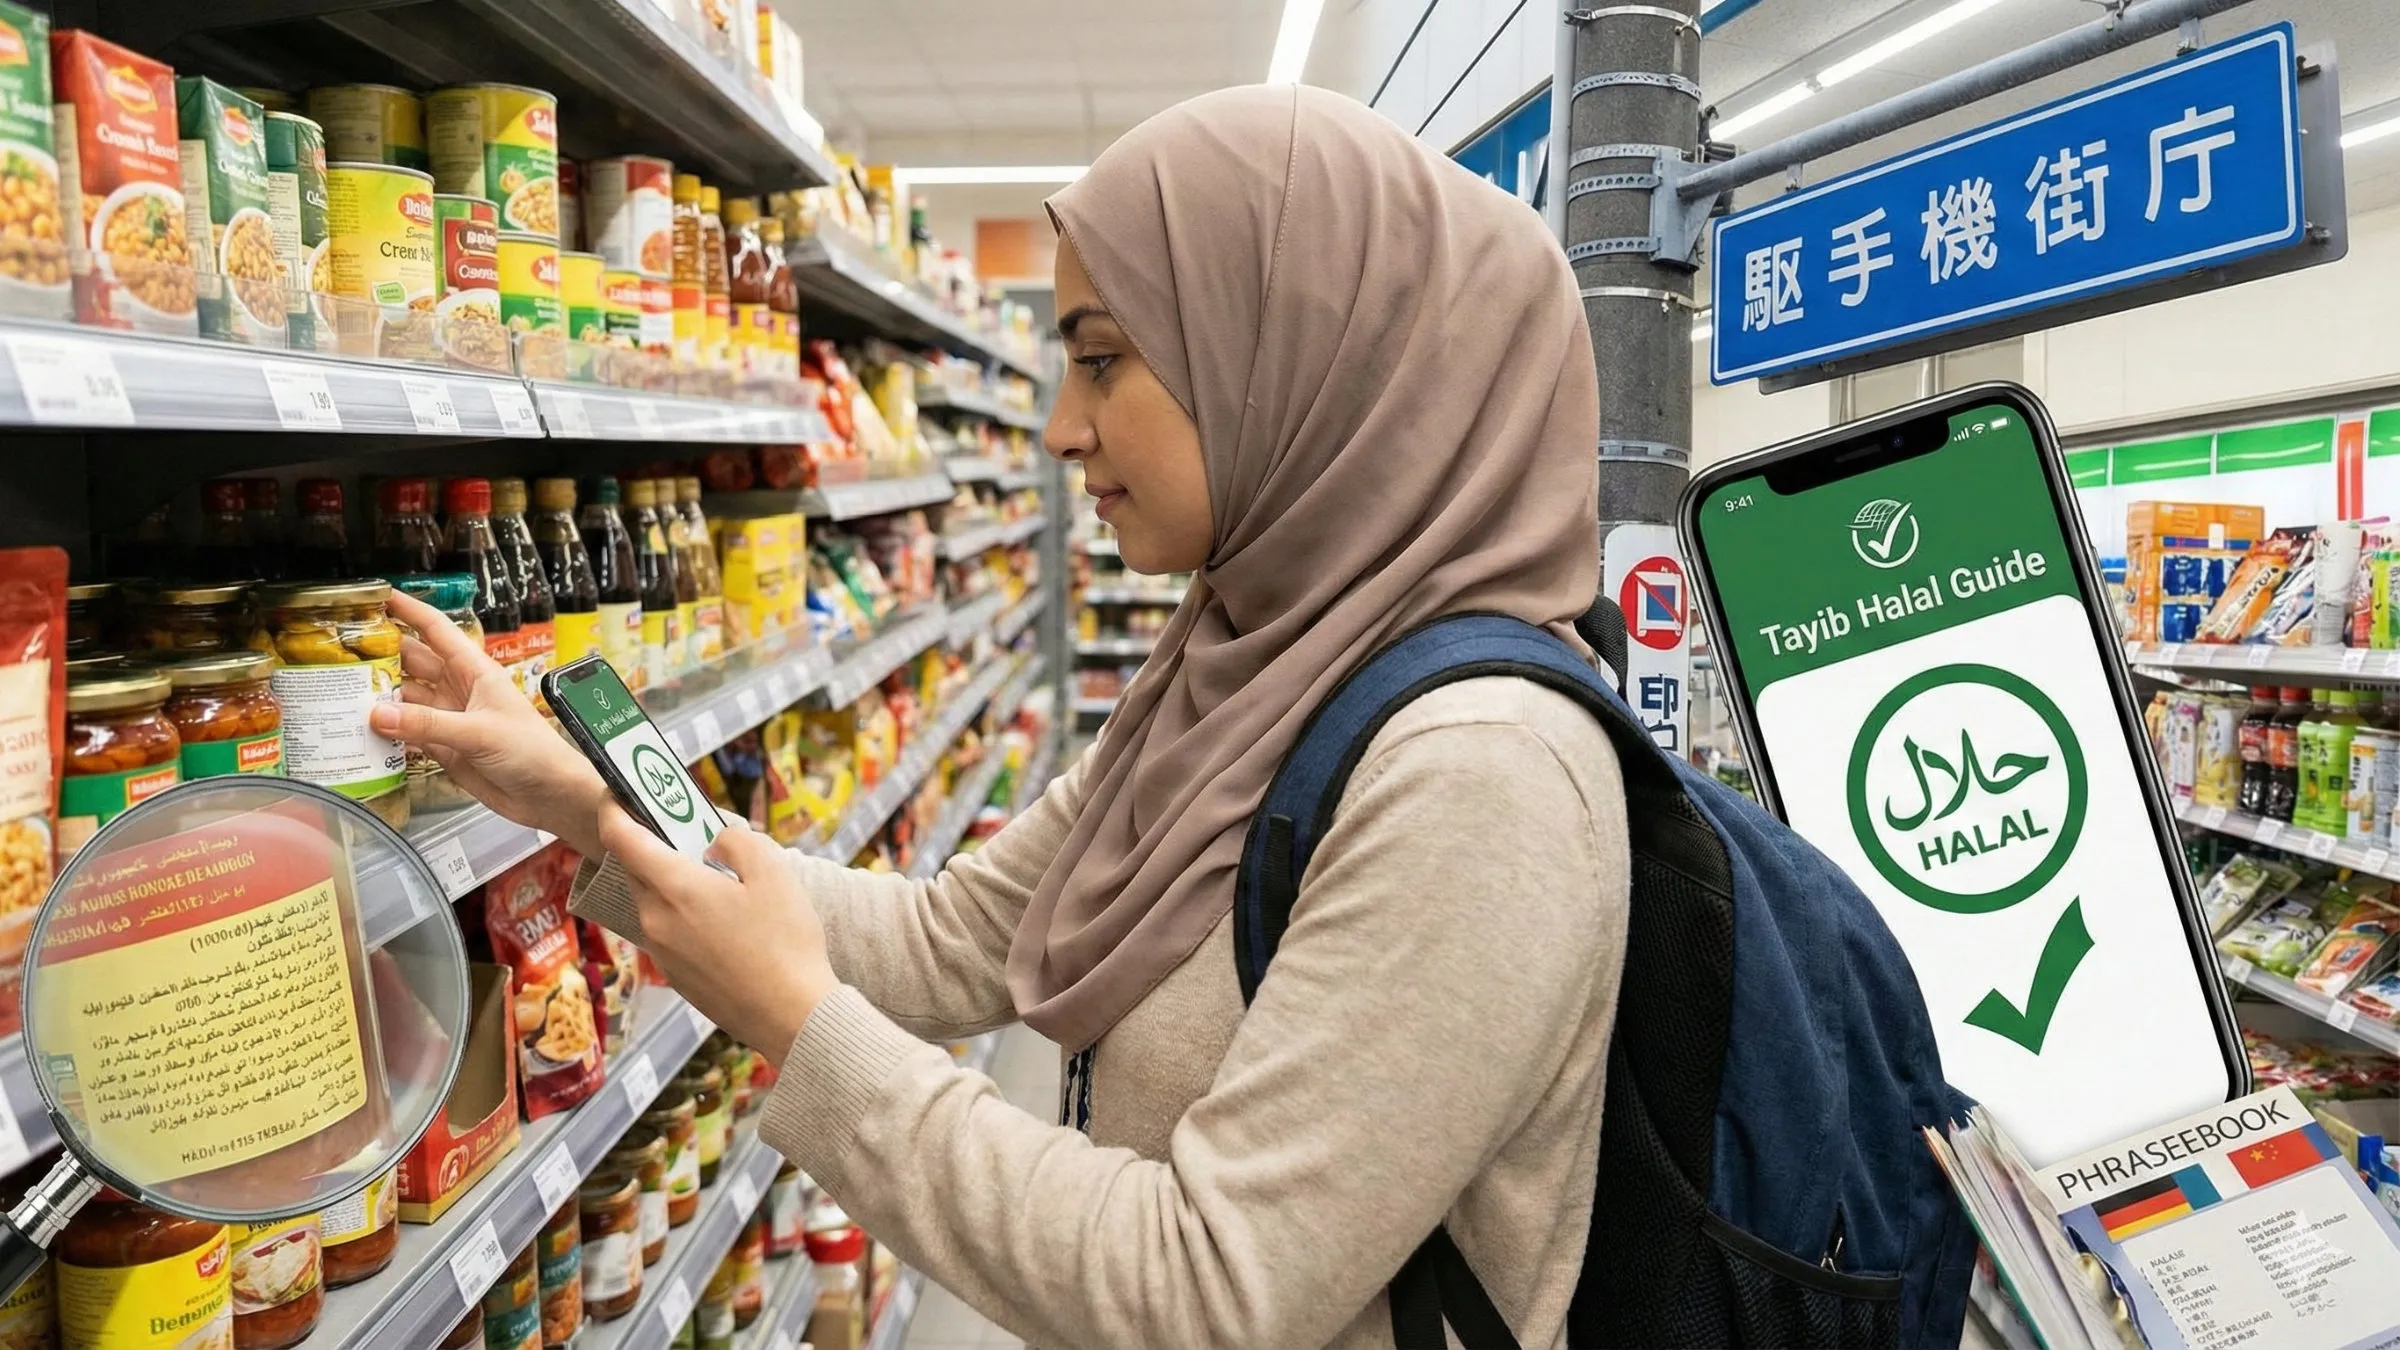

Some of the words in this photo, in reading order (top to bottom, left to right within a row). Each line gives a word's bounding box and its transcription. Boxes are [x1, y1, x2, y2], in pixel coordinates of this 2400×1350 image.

[1725, 494, 1754, 512] 9:41
[1759, 605, 1851, 656] Tayib
[1857, 574, 1944, 628] Halal
[1950, 548, 2047, 600] Guide
[1885, 728, 2050, 831] حلال
[1917, 809, 2049, 871] HALAL
[2056, 1099, 2290, 1200] PHRASEEBOOK
